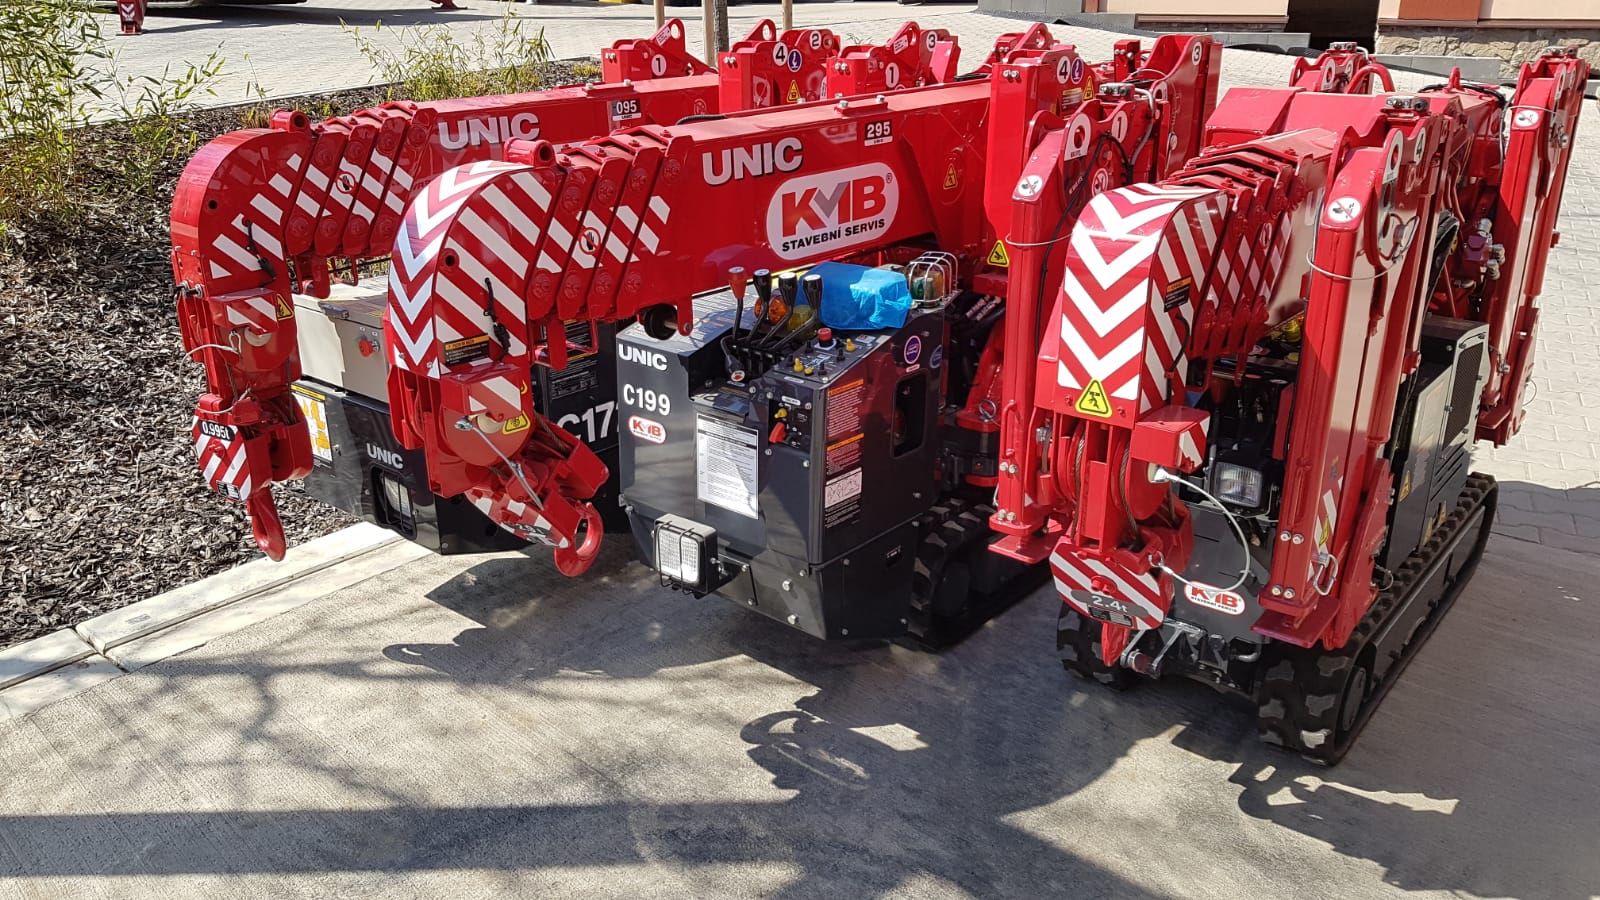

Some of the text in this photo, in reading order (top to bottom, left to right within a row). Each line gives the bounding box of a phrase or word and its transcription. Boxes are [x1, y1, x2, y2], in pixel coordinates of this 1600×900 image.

[810, 32, 821, 47] 2
[926, 33, 937, 49] 3
[774, 45, 786, 62] 4
[1192, 44, 1202, 63] 3
[1058, 59, 1070, 80] 4
[616, 99, 638, 115] 095
[438, 112, 540, 150] UNIC
[866, 120, 891, 139] 295
[702, 137, 804, 186] UNIC
[781, 218, 886, 252] STAVEBNÍ SERVIS
[618, 343, 668, 371] UNIC
[623, 383, 671, 416] C199
[201, 421, 231, 440] 0.995t
[556, 400, 619, 443] C17
[366, 443, 404, 469] UNIC
[1091, 595, 1128, 613] 2.4t
